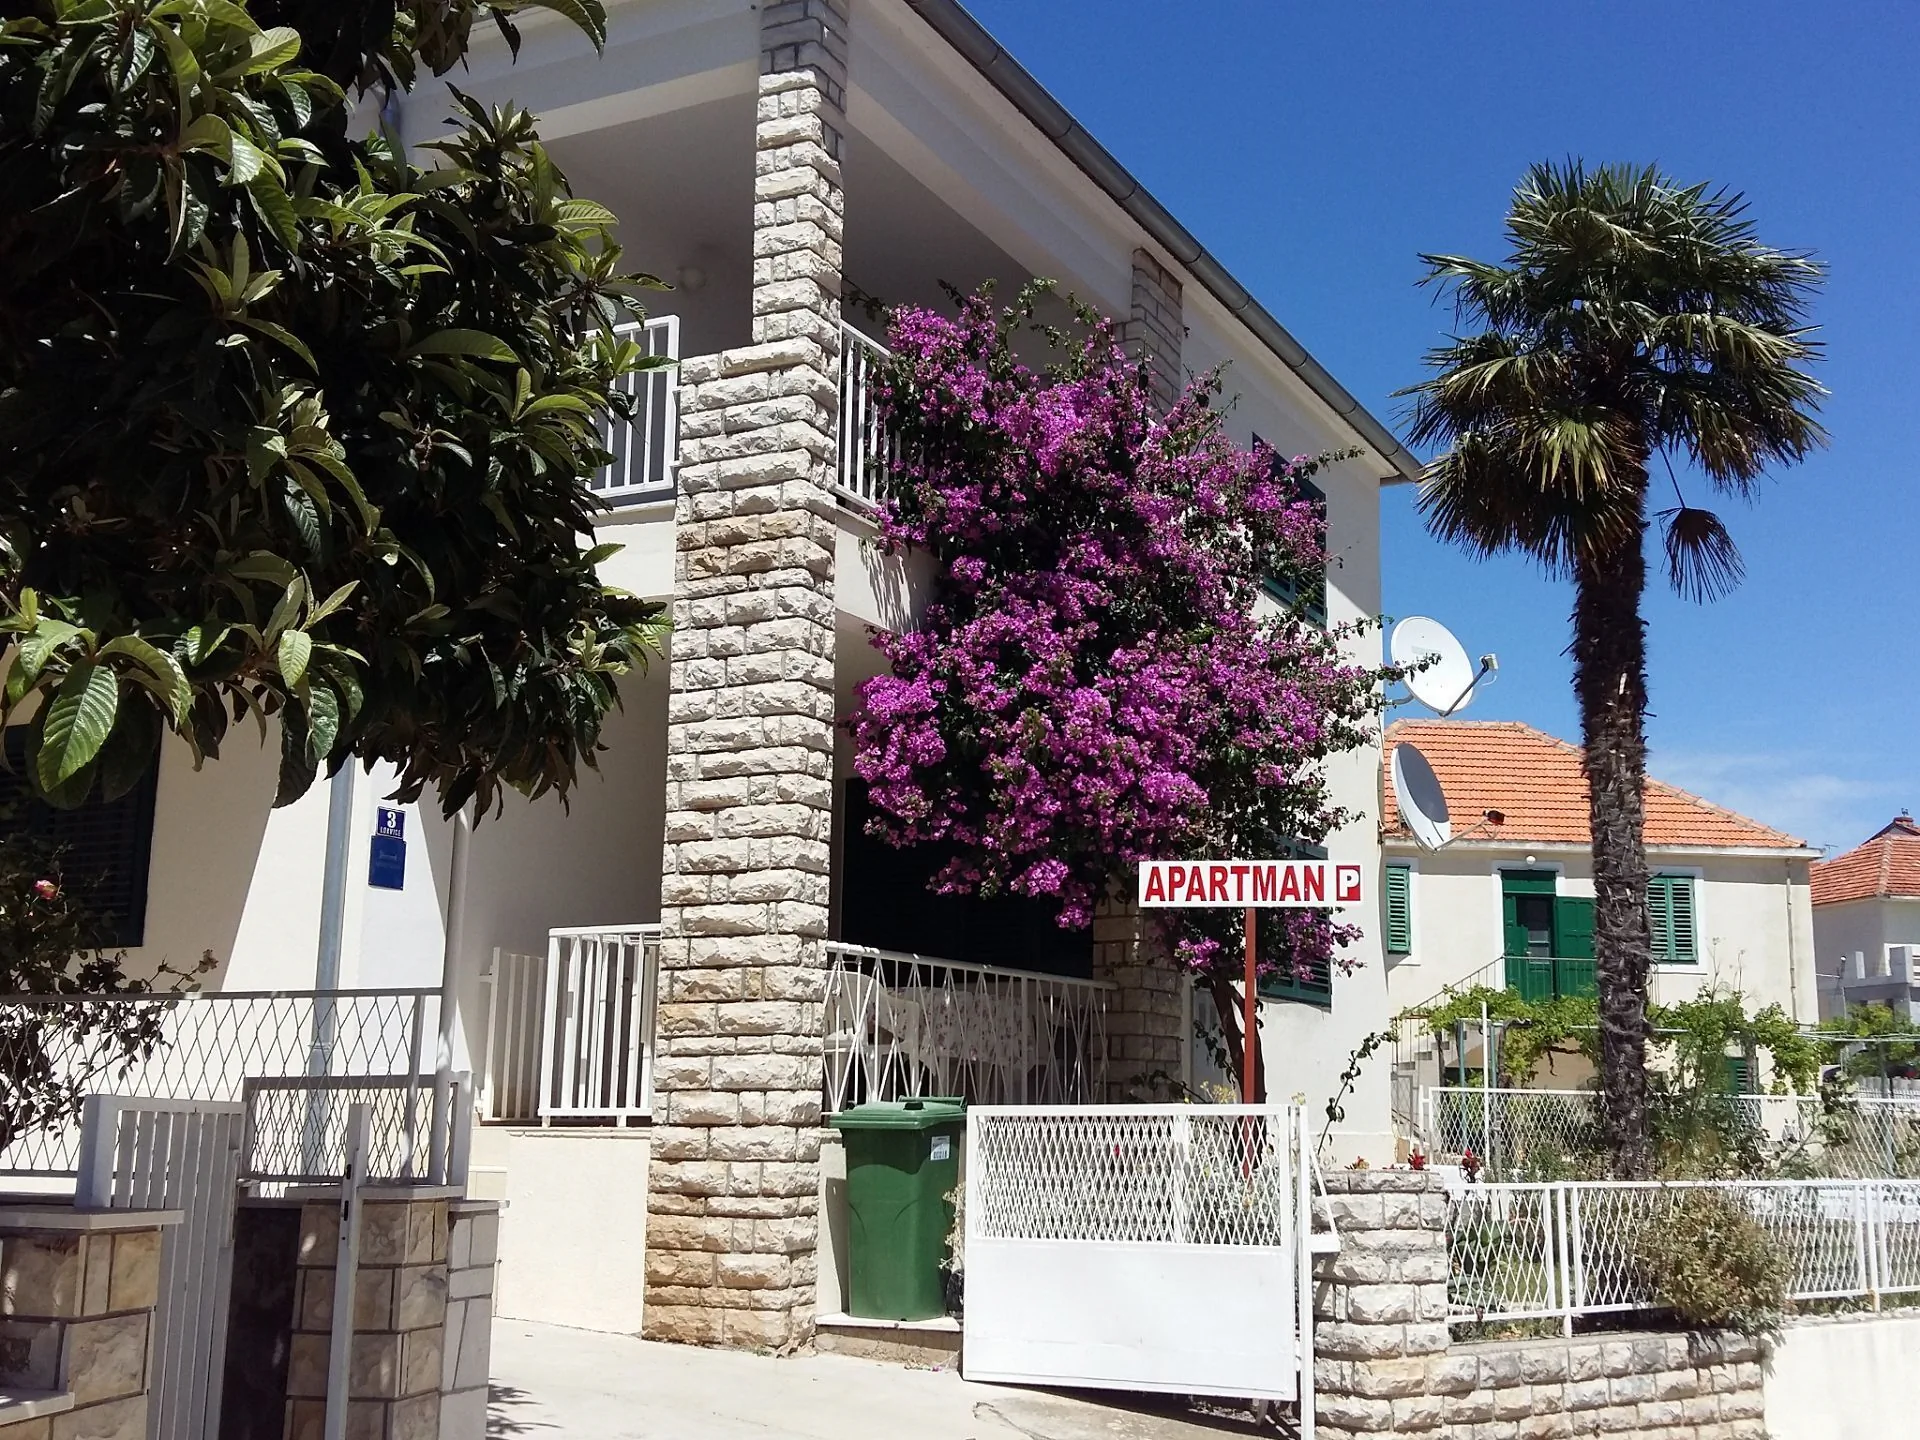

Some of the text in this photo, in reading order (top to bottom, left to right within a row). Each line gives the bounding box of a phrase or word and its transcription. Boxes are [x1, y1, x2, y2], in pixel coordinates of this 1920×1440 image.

[387, 811, 397, 829] 3
[1145, 865, 1360, 902] APARTMAN P
